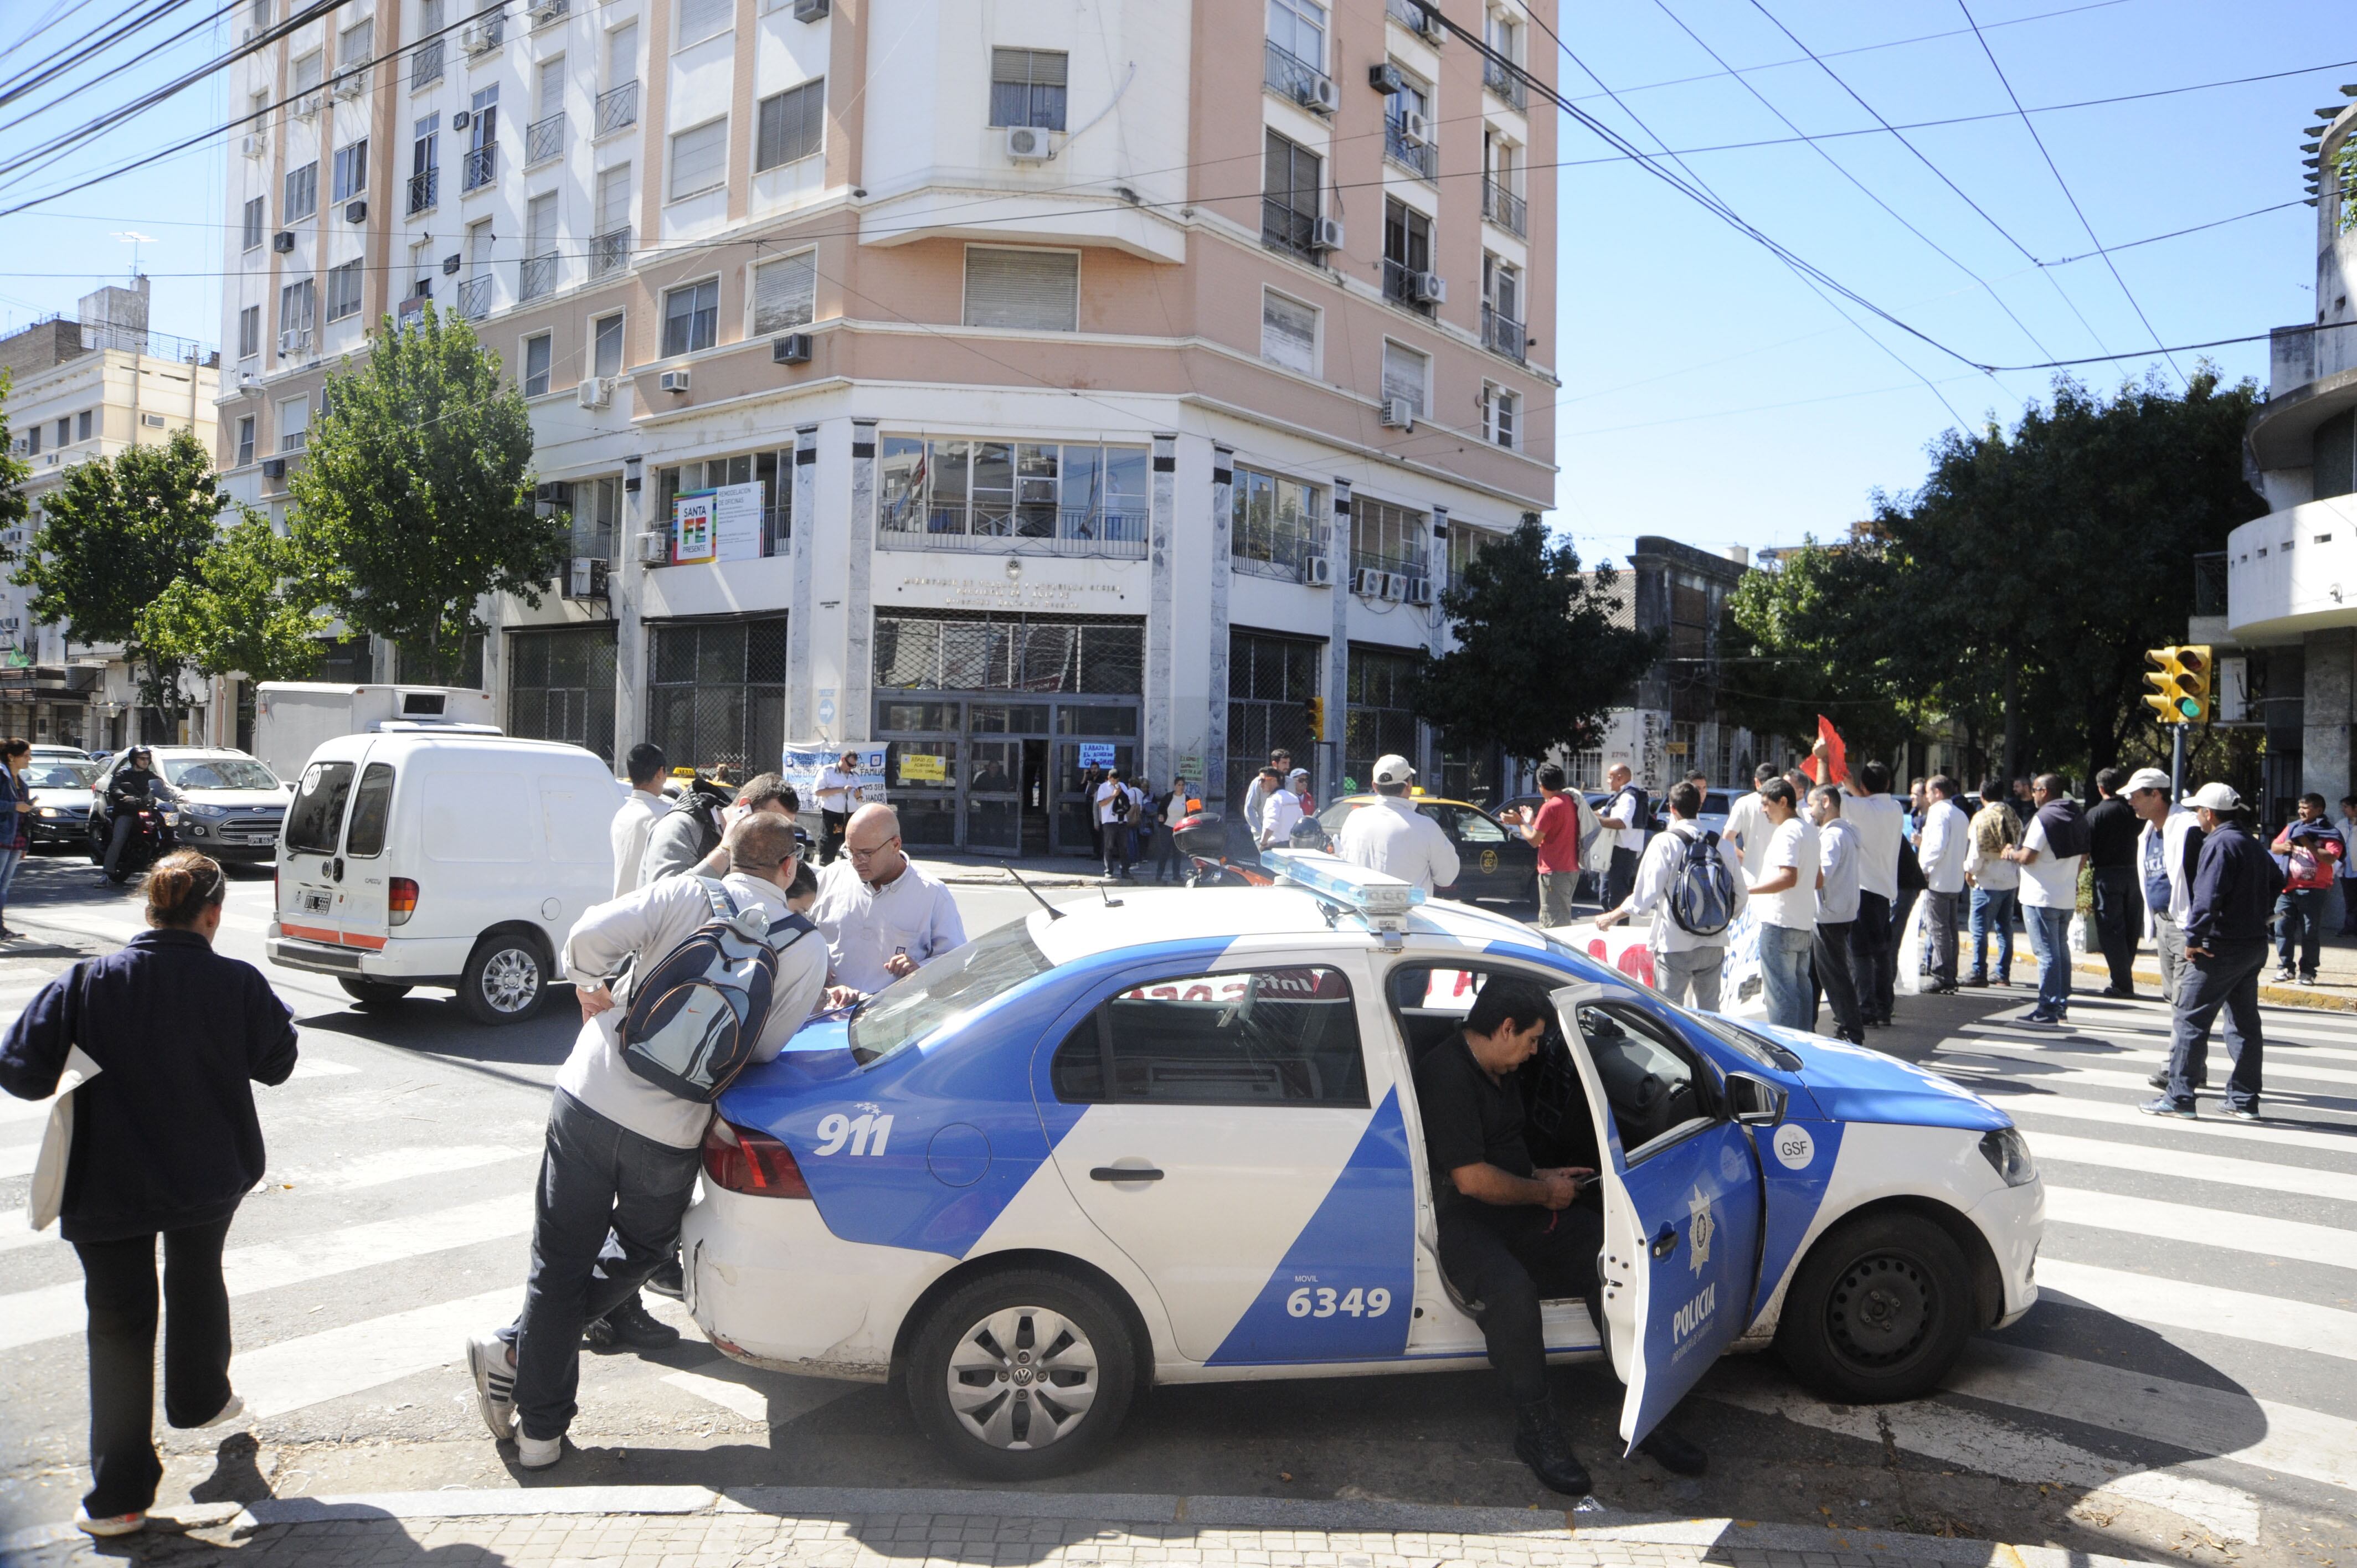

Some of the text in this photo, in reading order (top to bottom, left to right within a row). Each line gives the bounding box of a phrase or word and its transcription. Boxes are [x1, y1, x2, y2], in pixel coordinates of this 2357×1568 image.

[684, 506, 706, 517] SANTA
[683, 517, 706, 545] FE
[683, 544, 706, 553] PRESENTE
[304, 770, 320, 789] 110
[860, 768, 886, 777] FAMILIAS
[305, 896, 315, 908] DTL
[814, 1113, 894, 1156] 911
[1782, 1141, 1807, 1156] GSF
[1286, 1287, 1391, 1318] 6349
[1674, 1282, 1715, 1345] POLICIA
